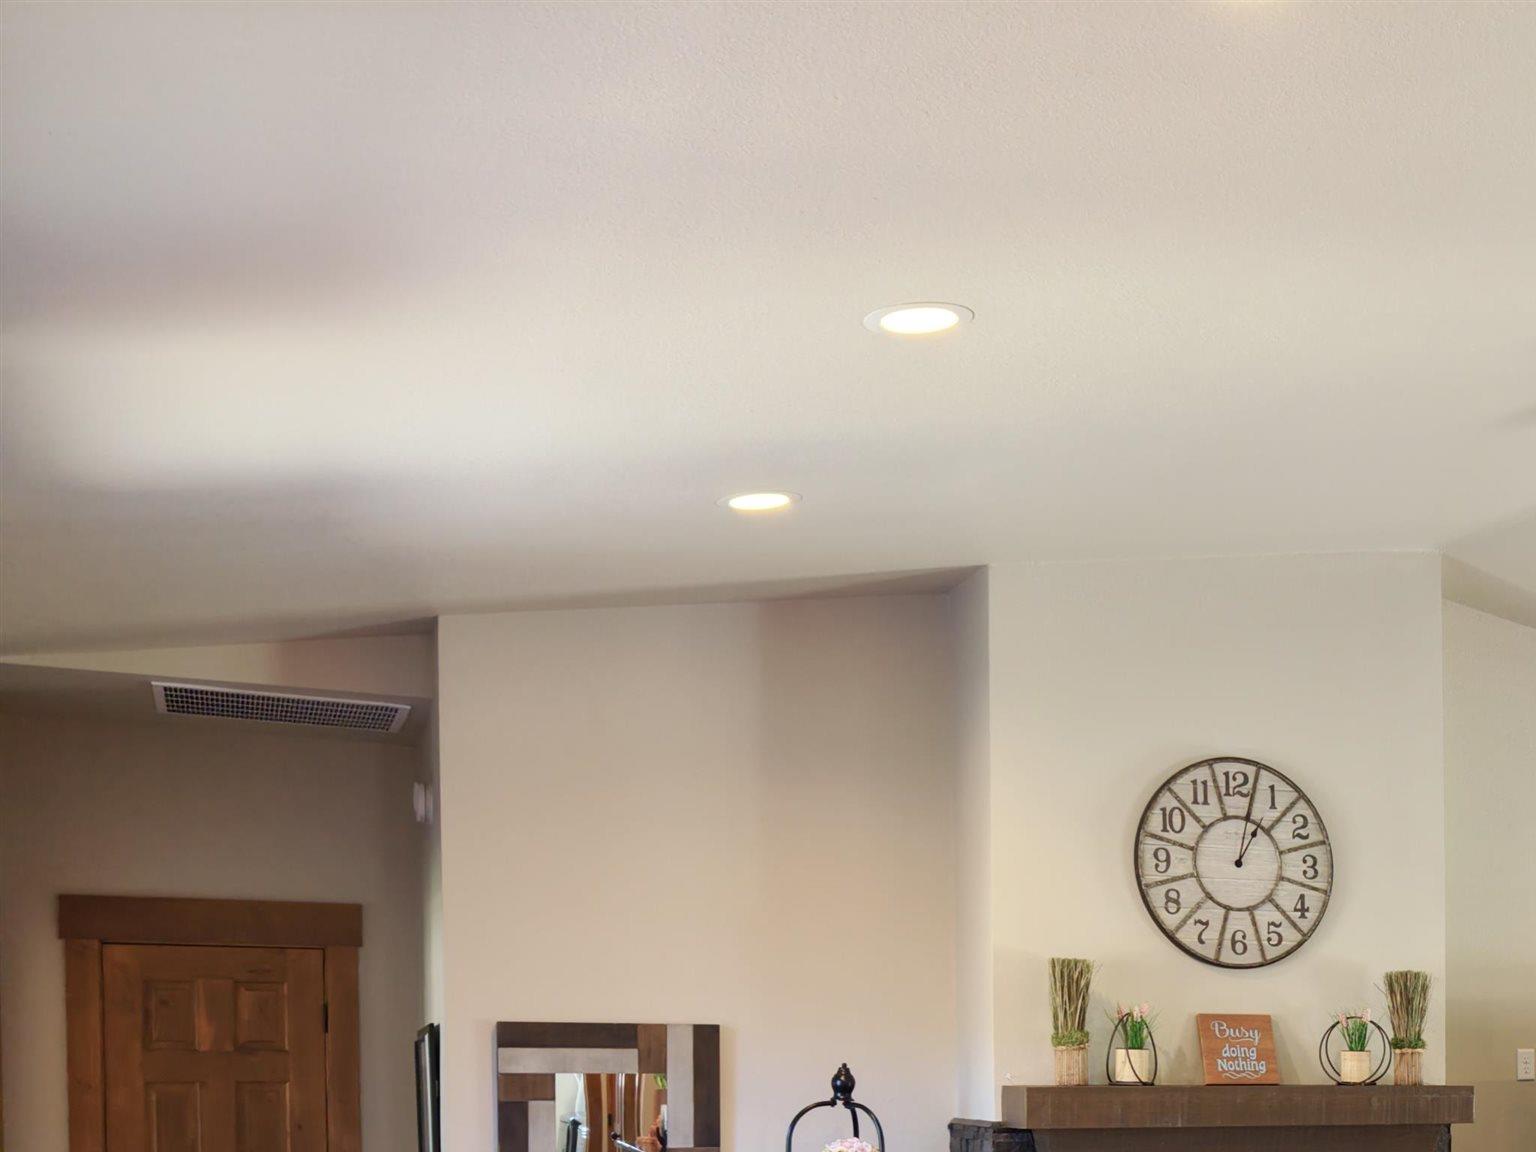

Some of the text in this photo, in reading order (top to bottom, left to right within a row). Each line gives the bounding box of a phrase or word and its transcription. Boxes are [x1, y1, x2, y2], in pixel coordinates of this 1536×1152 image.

[1190, 779, 1210, 806] 11
[1222, 771, 1250, 798] 12
[1267, 784, 1278, 810] 1
[1159, 806, 1186, 834] 10
[1291, 814, 1310, 840] 2
[1153, 847, 1171, 874] 9
[1302, 854, 1319, 880] 3
[1164, 888, 1181, 915] 8
[1293, 893, 1310, 919] 4
[1194, 918, 1210, 945] 7
[1230, 929, 1248, 956] 6
[1266, 921, 1283, 947] 5
[1210, 1020, 1261, 1046] Busy
[1222, 1044, 1257, 1060] doing
[1217, 1058, 1266, 1074] Nothing
